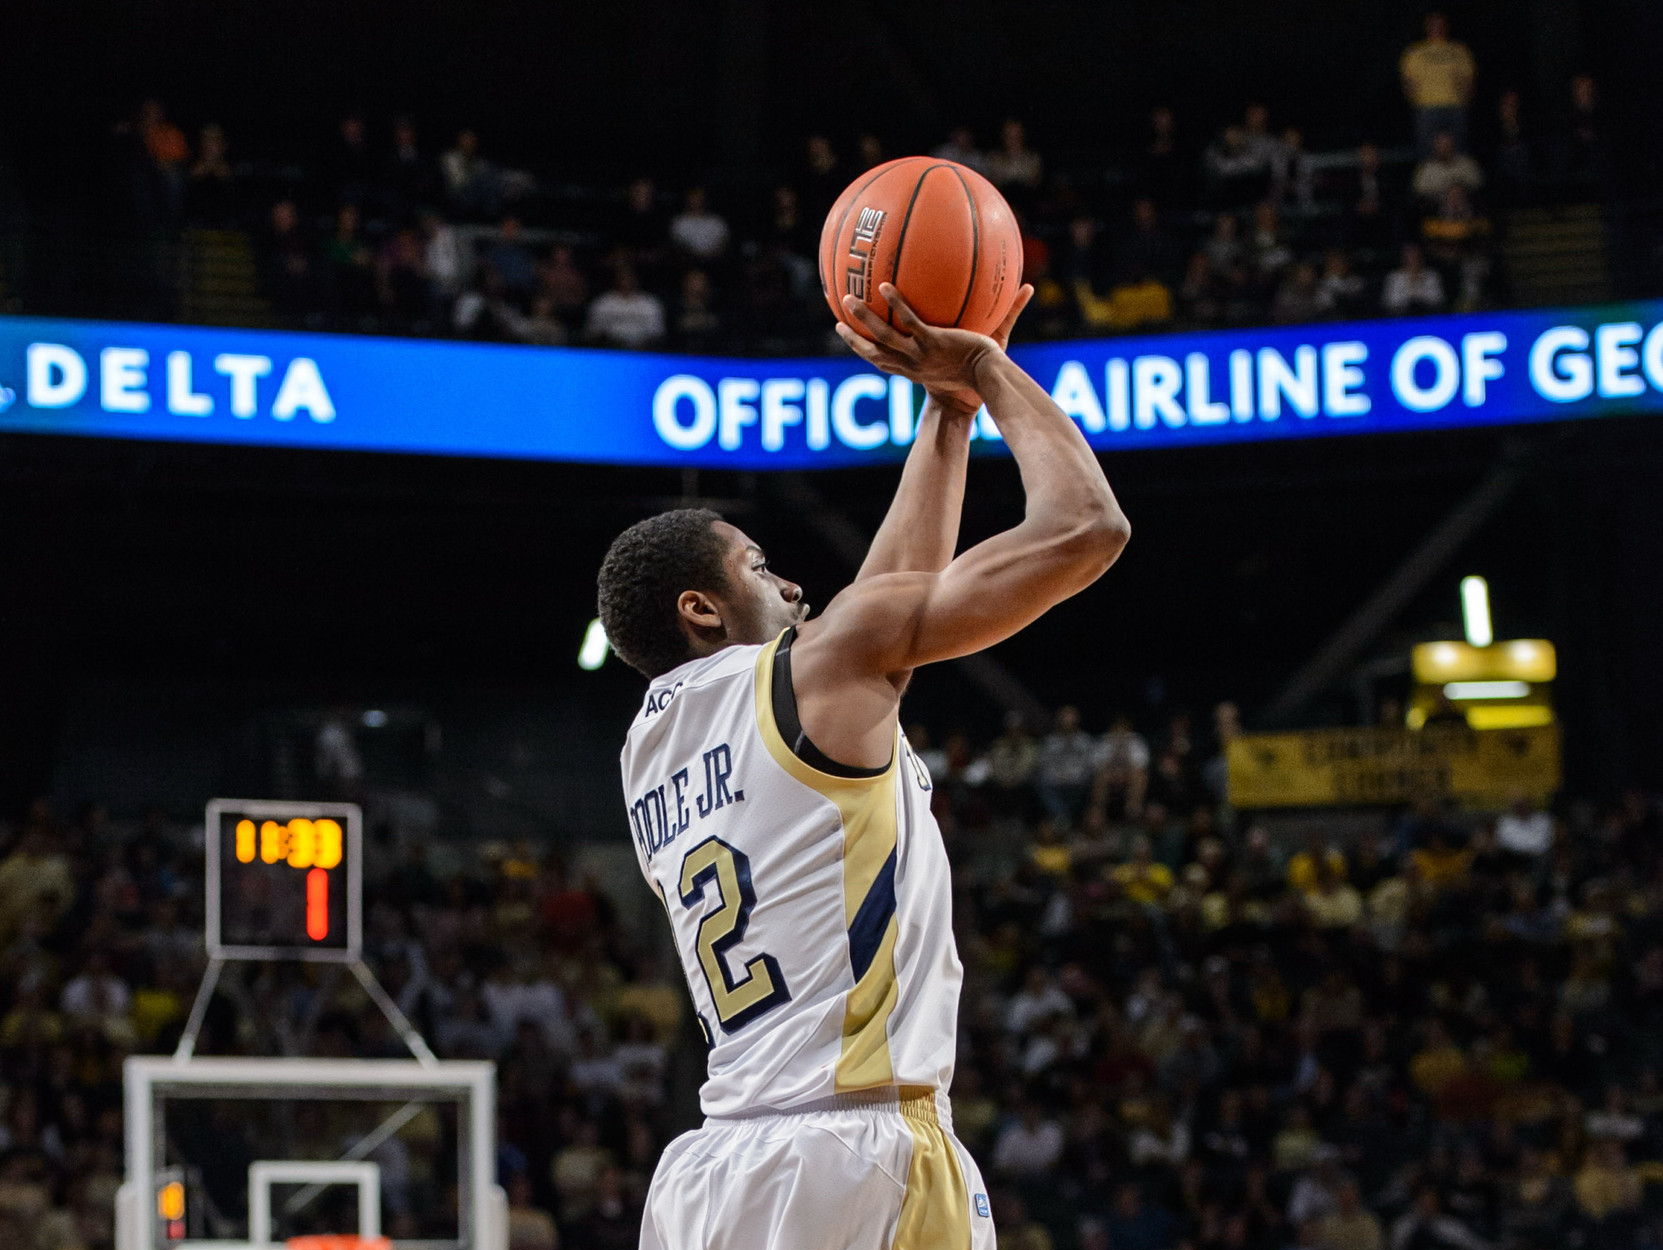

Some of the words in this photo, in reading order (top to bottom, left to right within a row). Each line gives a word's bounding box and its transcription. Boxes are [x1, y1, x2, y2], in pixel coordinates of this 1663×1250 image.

[846, 206, 884, 301] ELITE
[27, 343, 337, 424] DELTA
[652, 373, 1004, 452] OFFICI
[1050, 341, 1372, 433] AIRLINE
[1389, 331, 1507, 413] OF
[696, 743, 745, 819] JR.
[657, 834, 793, 1049] 2
